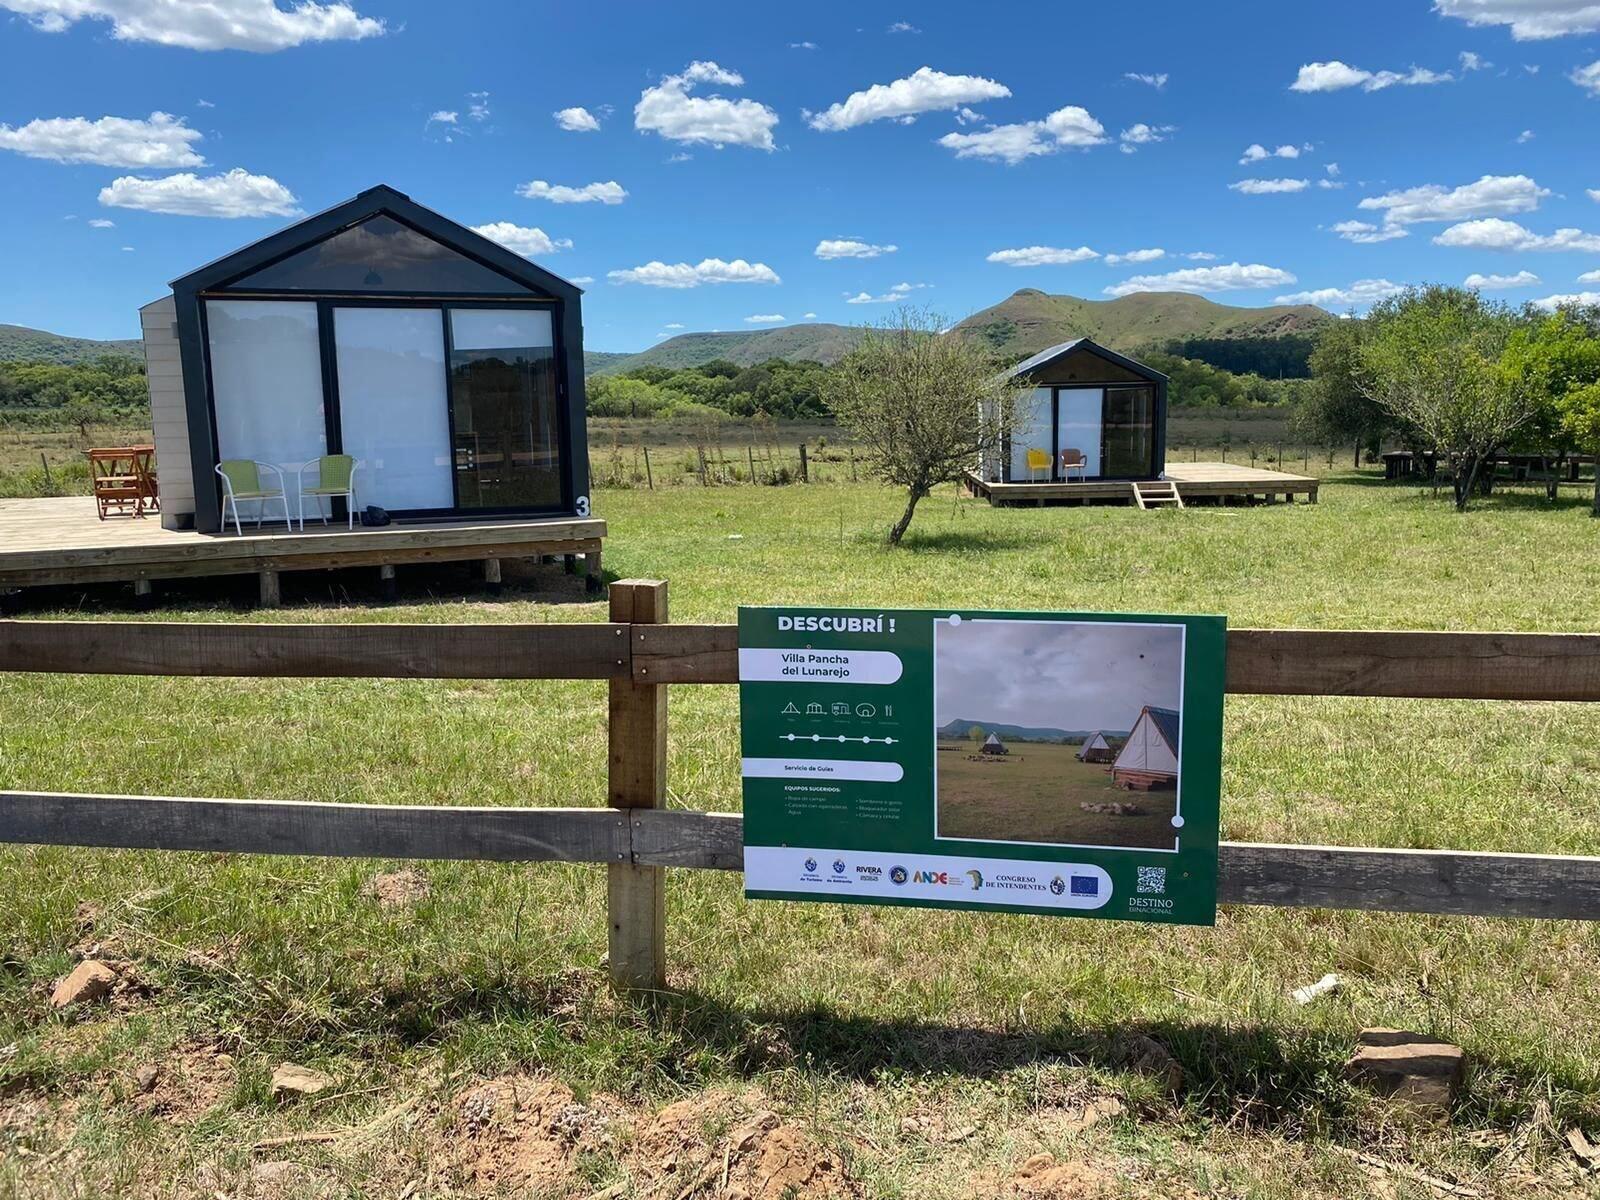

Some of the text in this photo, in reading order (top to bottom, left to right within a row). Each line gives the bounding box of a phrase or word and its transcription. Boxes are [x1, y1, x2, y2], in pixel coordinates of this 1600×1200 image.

[576, 496, 589, 517] 3
[778, 614, 896, 633] DESCUBRÍ !
[781, 653, 849, 664] Villa Pancha
[782, 666, 850, 678] del Lunarejo
[856, 866, 882, 874] RIVERA
[913, 870, 948, 885] ANDE
[996, 874, 1036, 883] CONGRESO
[997, 882, 1047, 891] INTENDENTES
[1129, 897, 1174, 908] DESTINO
[1128, 906, 1172, 914] BINACIONAL
